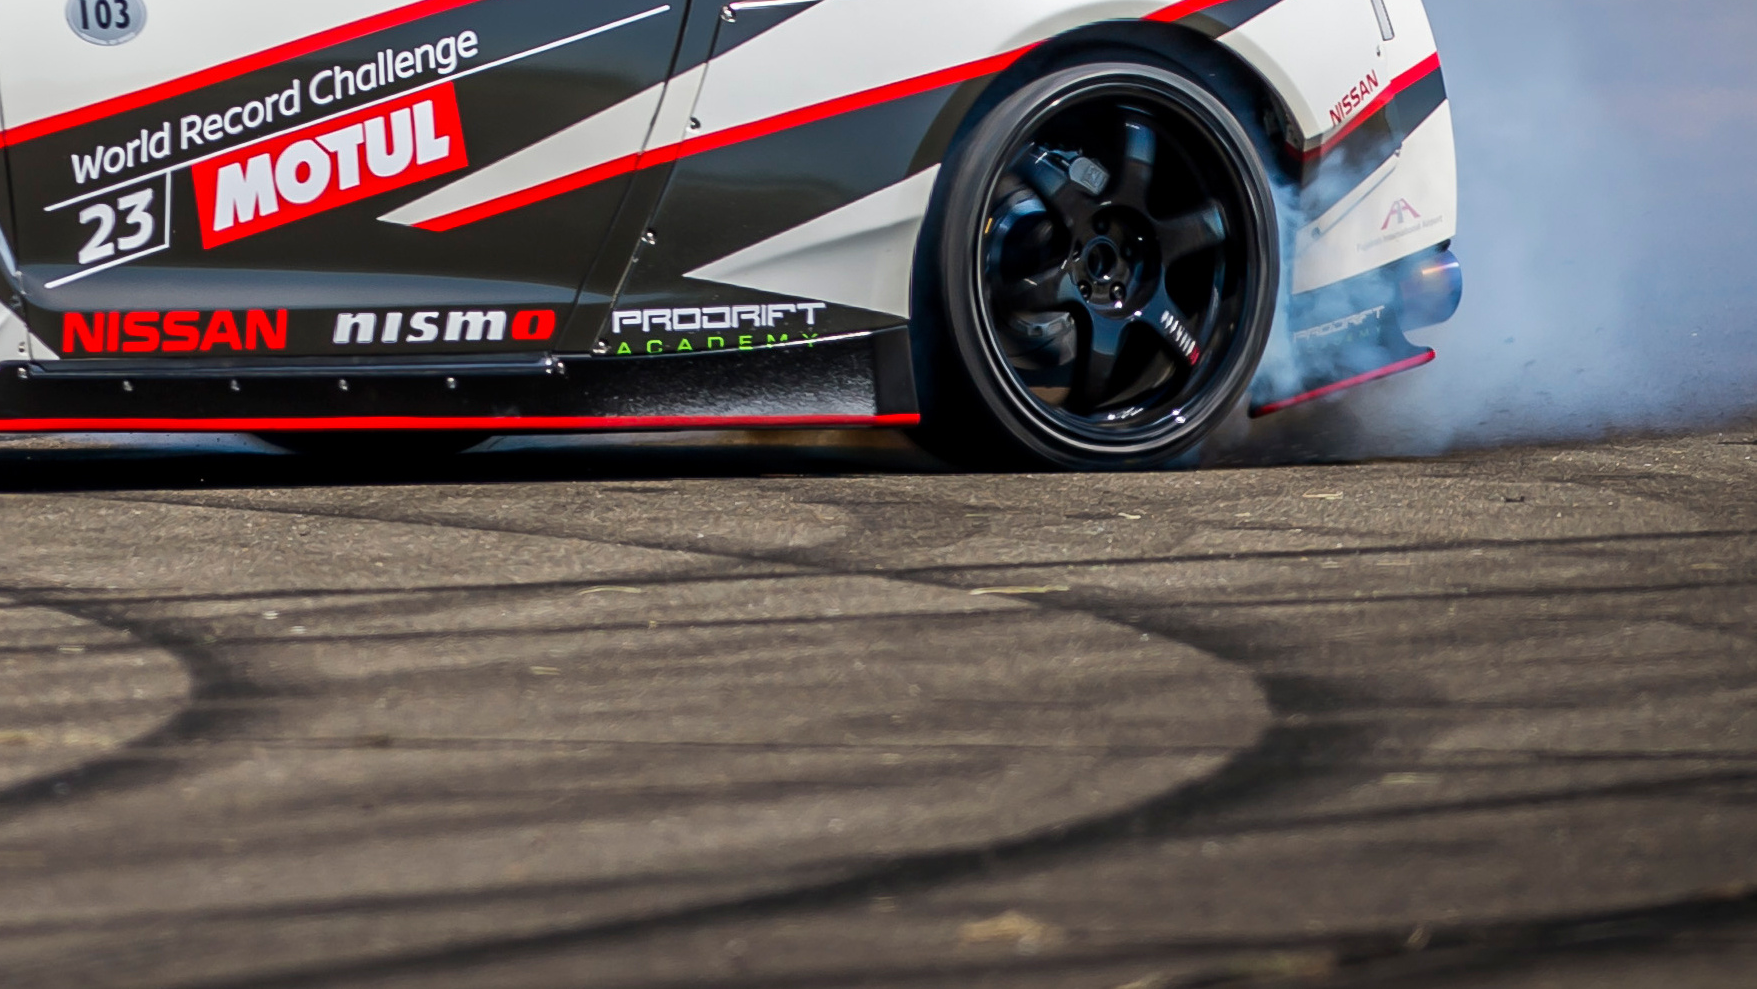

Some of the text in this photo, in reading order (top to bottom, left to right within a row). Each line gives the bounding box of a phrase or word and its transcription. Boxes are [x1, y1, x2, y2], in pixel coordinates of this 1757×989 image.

[71, 29, 478, 184] World Record Challenge
[1329, 69, 1379, 127] NISSAN
[213, 99, 450, 232] MOTUL
[78, 187, 155, 265] 23
[62, 308, 288, 353] NISSAN
[612, 302, 827, 333] PRODRIFT
[617, 333, 819, 355] ACADEMY
